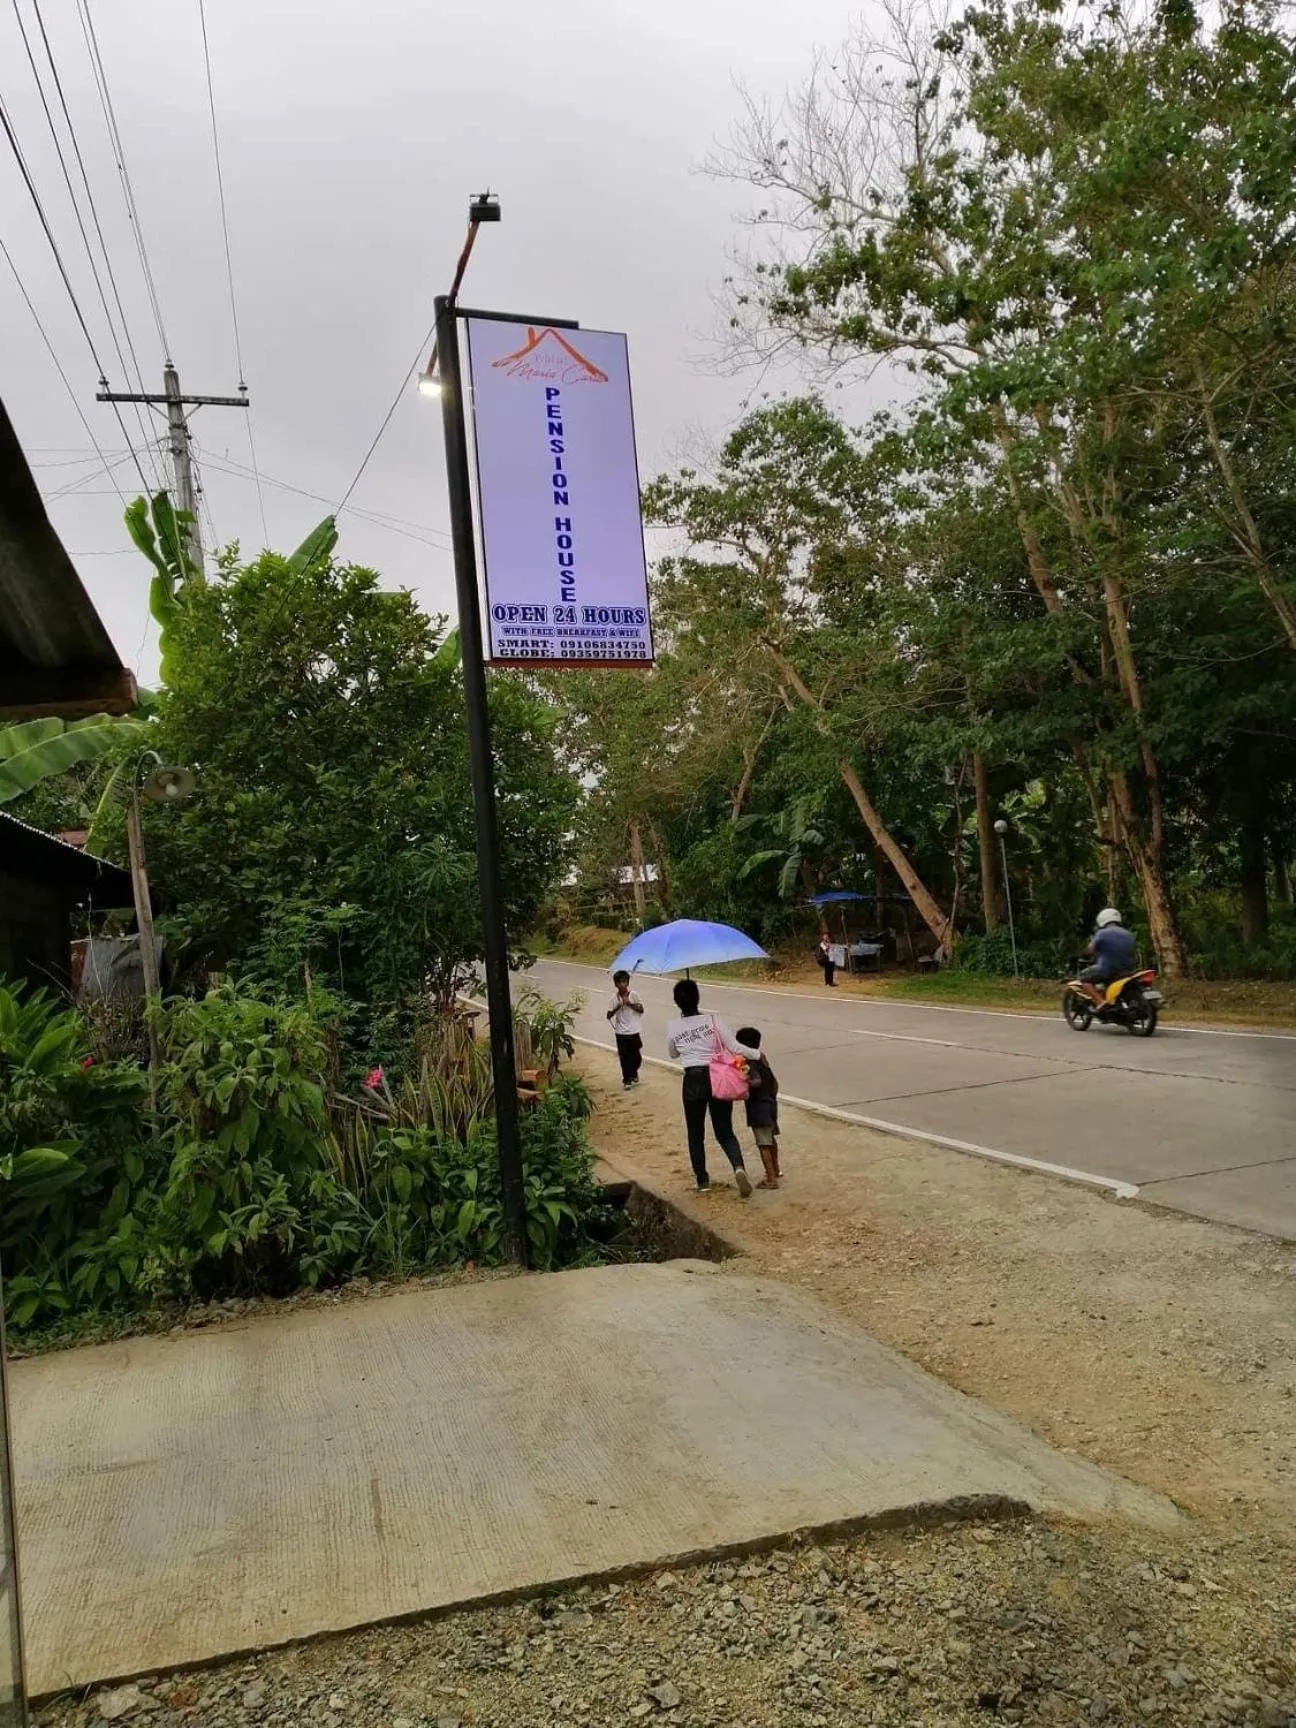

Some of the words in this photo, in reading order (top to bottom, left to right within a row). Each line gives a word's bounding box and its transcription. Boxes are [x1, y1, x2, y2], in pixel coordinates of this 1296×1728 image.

[546, 388, 569, 506] PENSION
[556, 517, 577, 603] HOUSE
[491, 603, 547, 624] OPEN
[553, 605, 577, 625] 24
[582, 605, 646, 626] HOURS
[503, 627, 527, 637] WITH
[531, 628, 555, 638] FREE
[557, 628, 607, 638] BREAKFAST
[609, 629, 616, 638] &
[619, 629, 641, 638] WIFI
[498, 639, 554, 649] SMART:
[499, 649, 555, 658] GLOBE:
